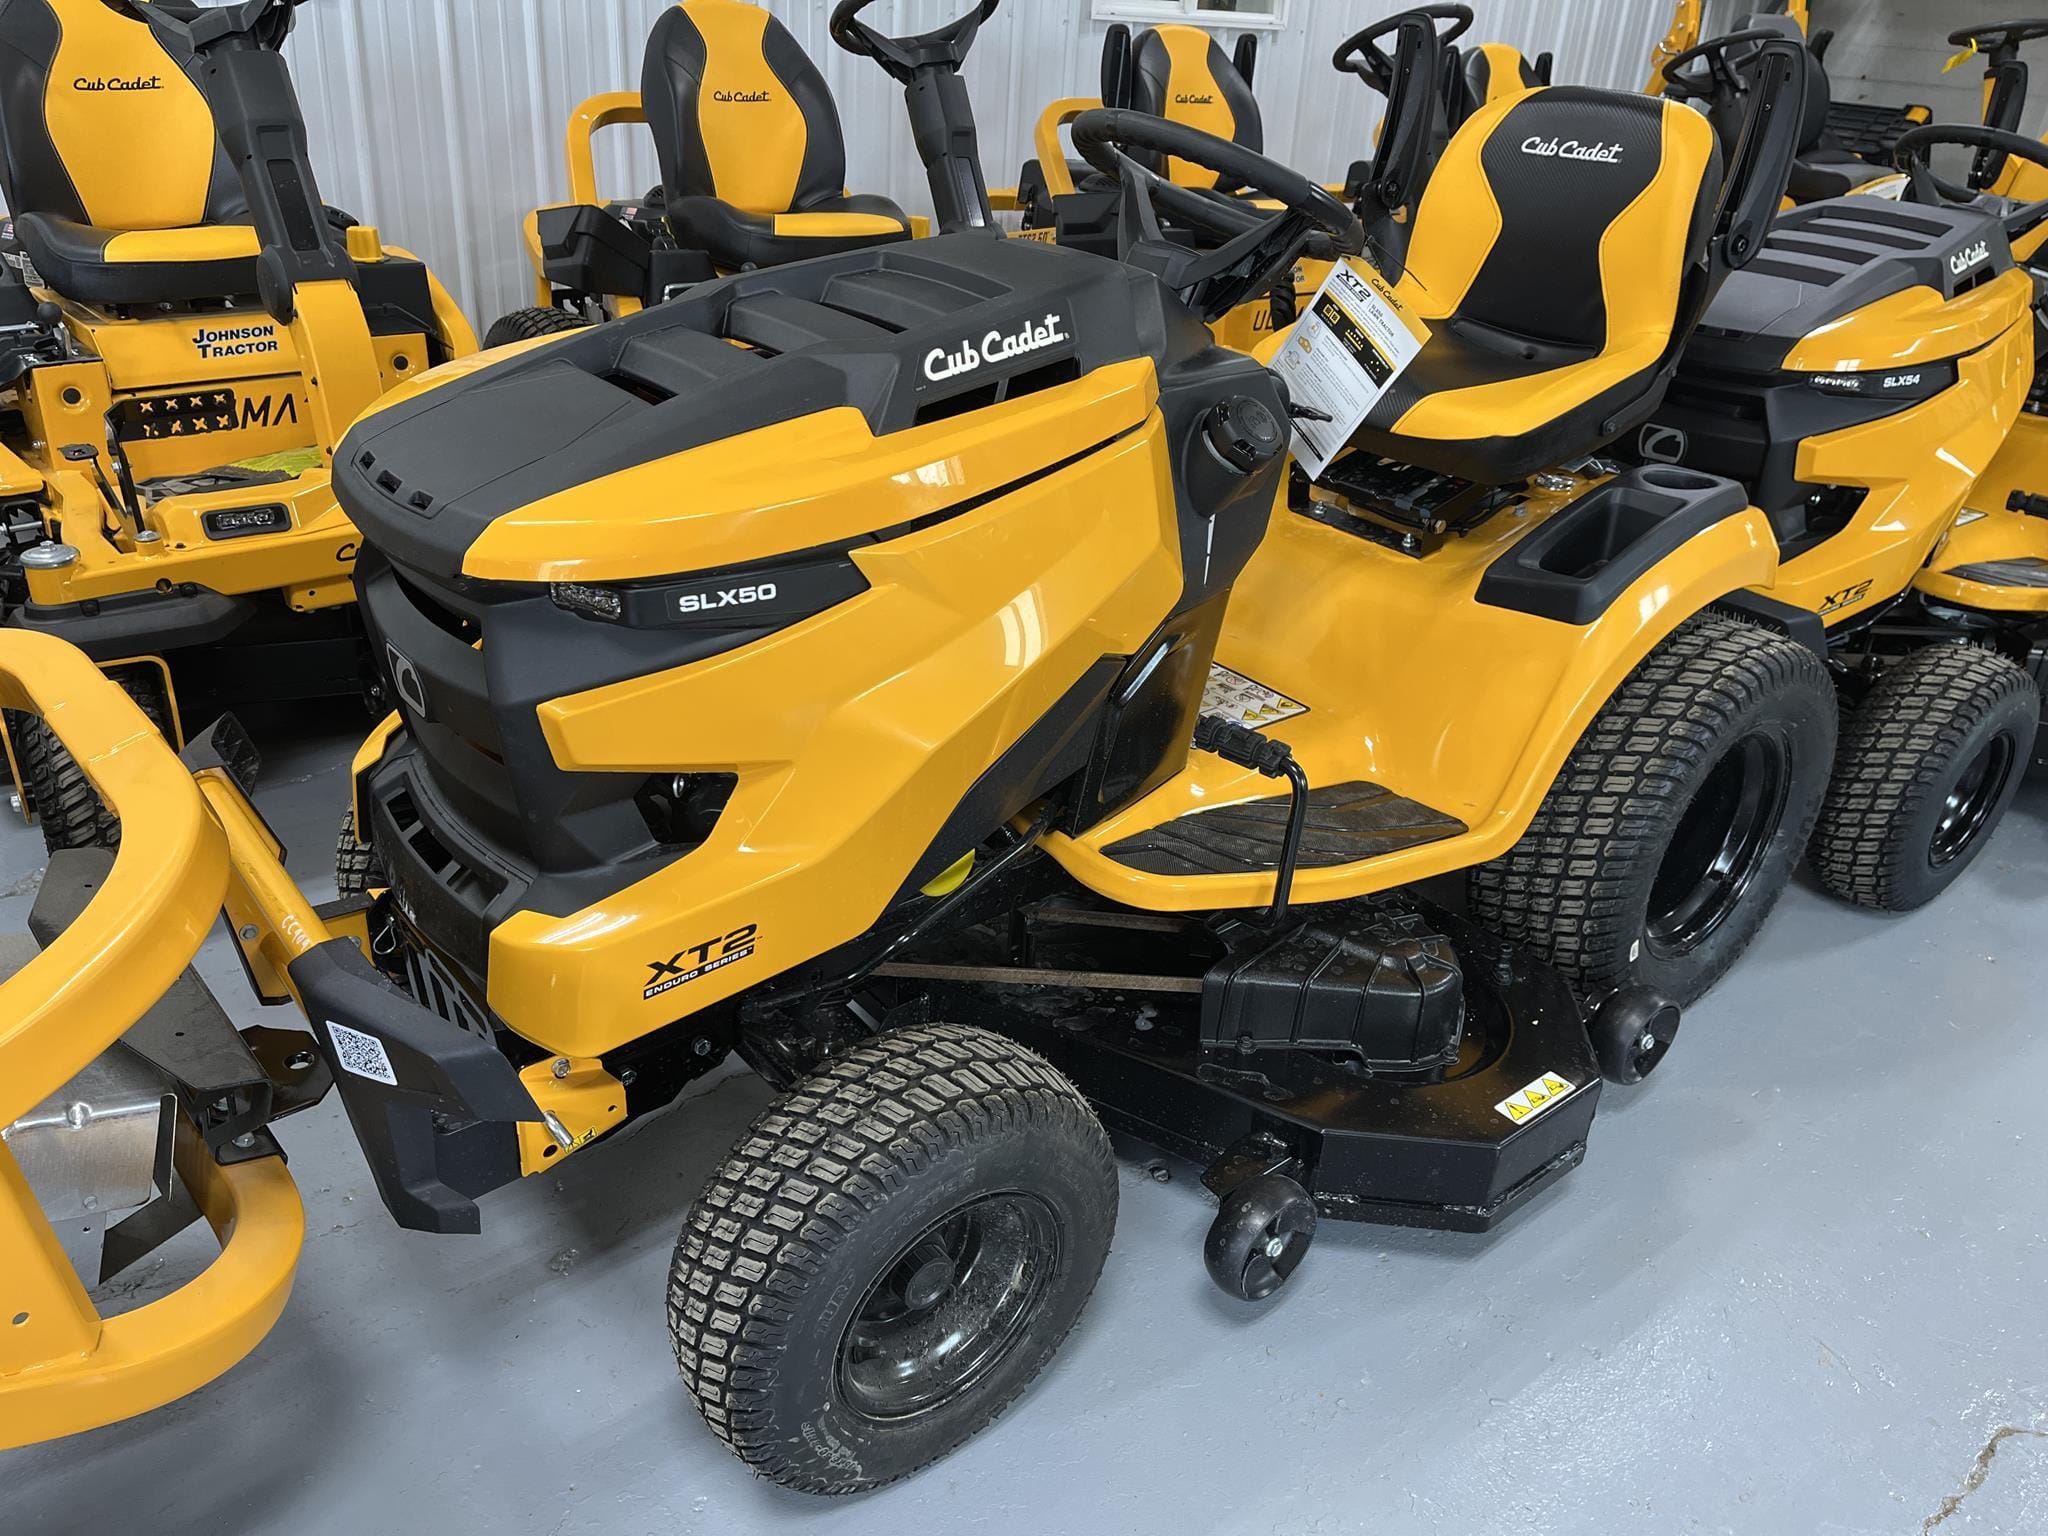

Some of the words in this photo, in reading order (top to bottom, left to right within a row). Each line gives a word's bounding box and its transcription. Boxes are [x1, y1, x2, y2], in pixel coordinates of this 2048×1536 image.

[73, 77, 106, 91] Cub
[107, 75, 161, 91] Cadet
[713, 90, 733, 102] Cub
[733, 90, 769, 102] Cadet
[1521, 136, 1559, 156] Cub
[1558, 140, 1624, 163] Cadet
[1339, 269, 1372, 299] XT2
[1371, 278, 1385, 293] Cub
[1382, 290, 1404, 311] Cadet
[192, 325, 274, 344] JOHNSON
[197, 341, 278, 358] TRACTOR
[923, 340, 981, 382] Cub
[981, 313, 1064, 363] Cadet
[1883, 374, 1921, 388] SLX54
[240, 393, 298, 429] MA
[679, 583, 777, 613] SLX50
[1818, 578, 1874, 611] XT2
[643, 923, 758, 988] XT2
[645, 971, 699, 998] ENDURO
[704, 948, 749, 973] SERIES
